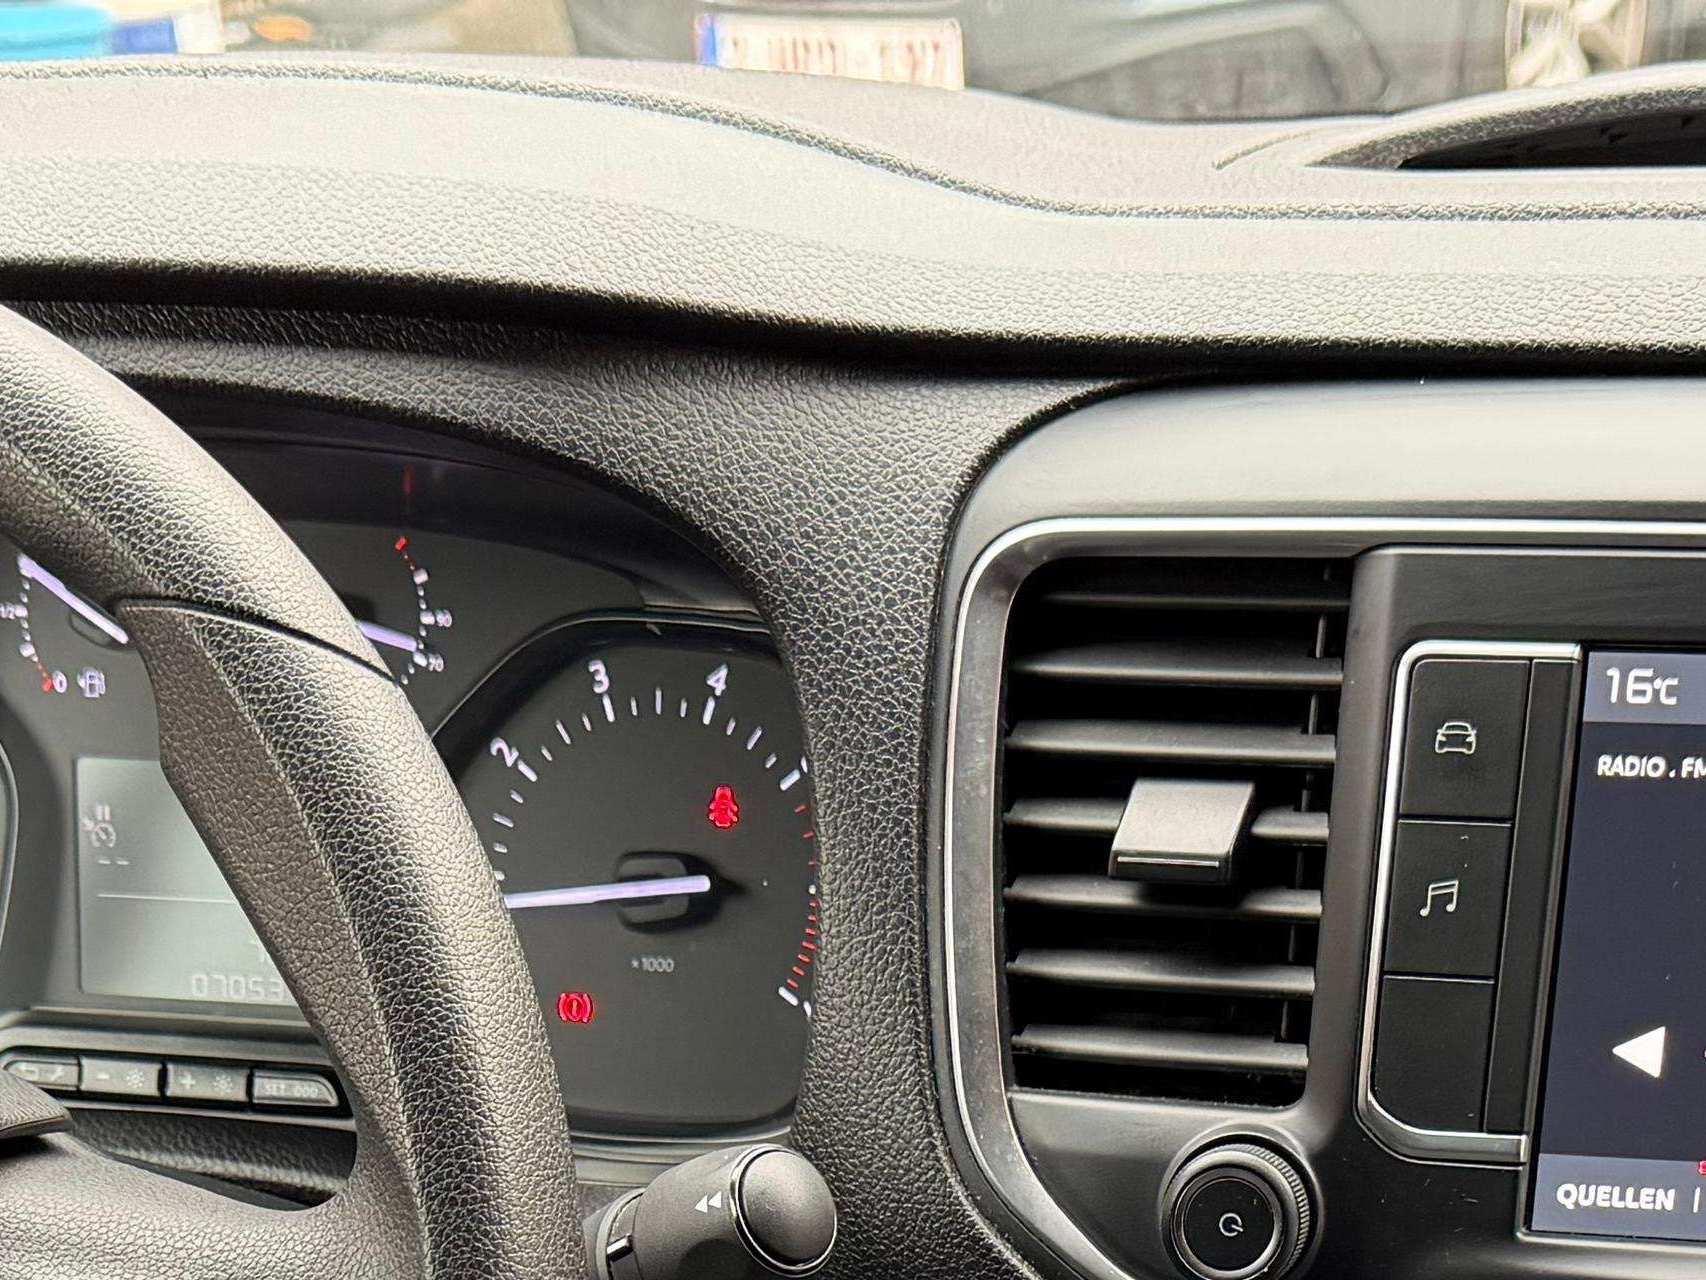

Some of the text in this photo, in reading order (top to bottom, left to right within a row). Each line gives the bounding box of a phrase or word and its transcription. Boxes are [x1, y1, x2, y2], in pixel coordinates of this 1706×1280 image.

[588, 660, 611, 694] 3
[706, 663, 730, 696] 4
[490, 737, 520, 767] 2
[1556, 1183, 1675, 1211] QUELLEN
